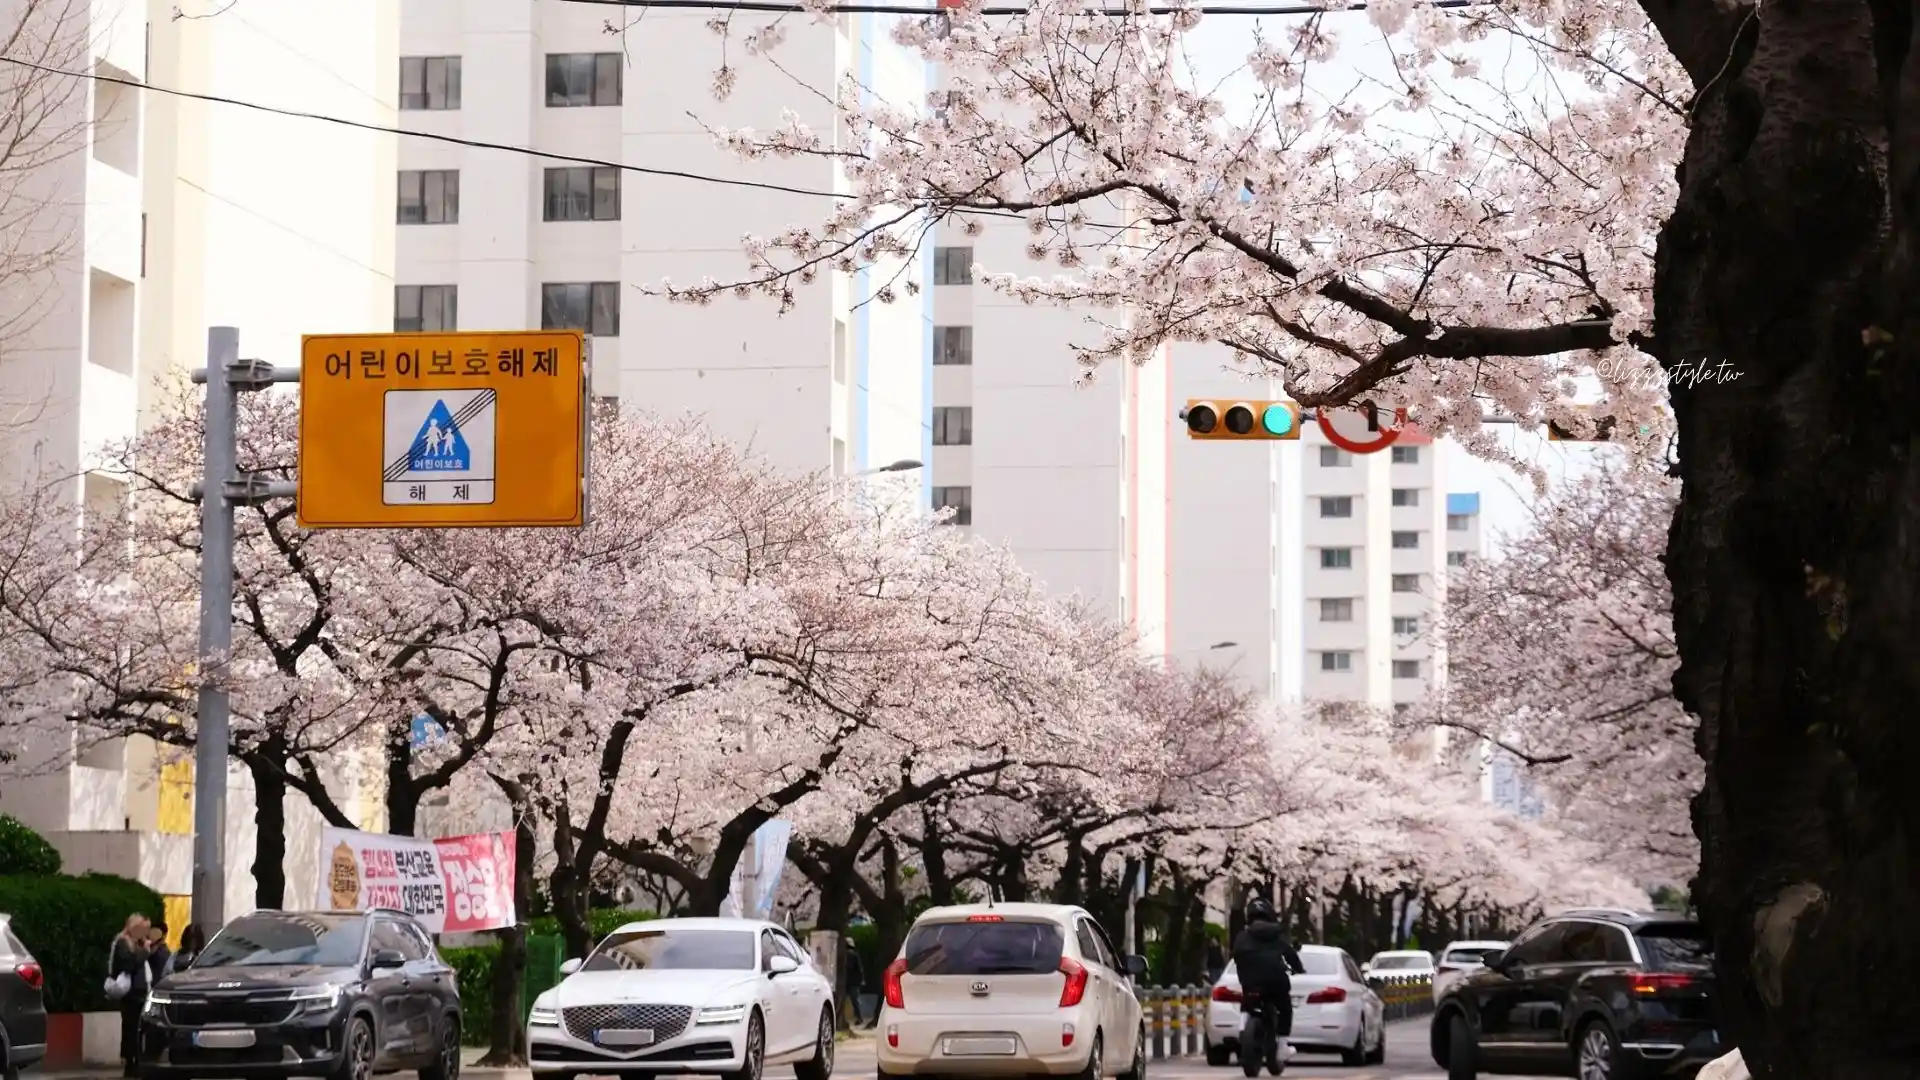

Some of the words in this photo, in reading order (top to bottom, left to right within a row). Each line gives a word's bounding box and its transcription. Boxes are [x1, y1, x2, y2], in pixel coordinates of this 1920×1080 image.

[325, 347, 559, 380] 어린이보호해제
[413, 458, 464, 470] 어린이보호
[396, 848, 440, 880] 부산교육
[402, 884, 445, 915] 대한민국
